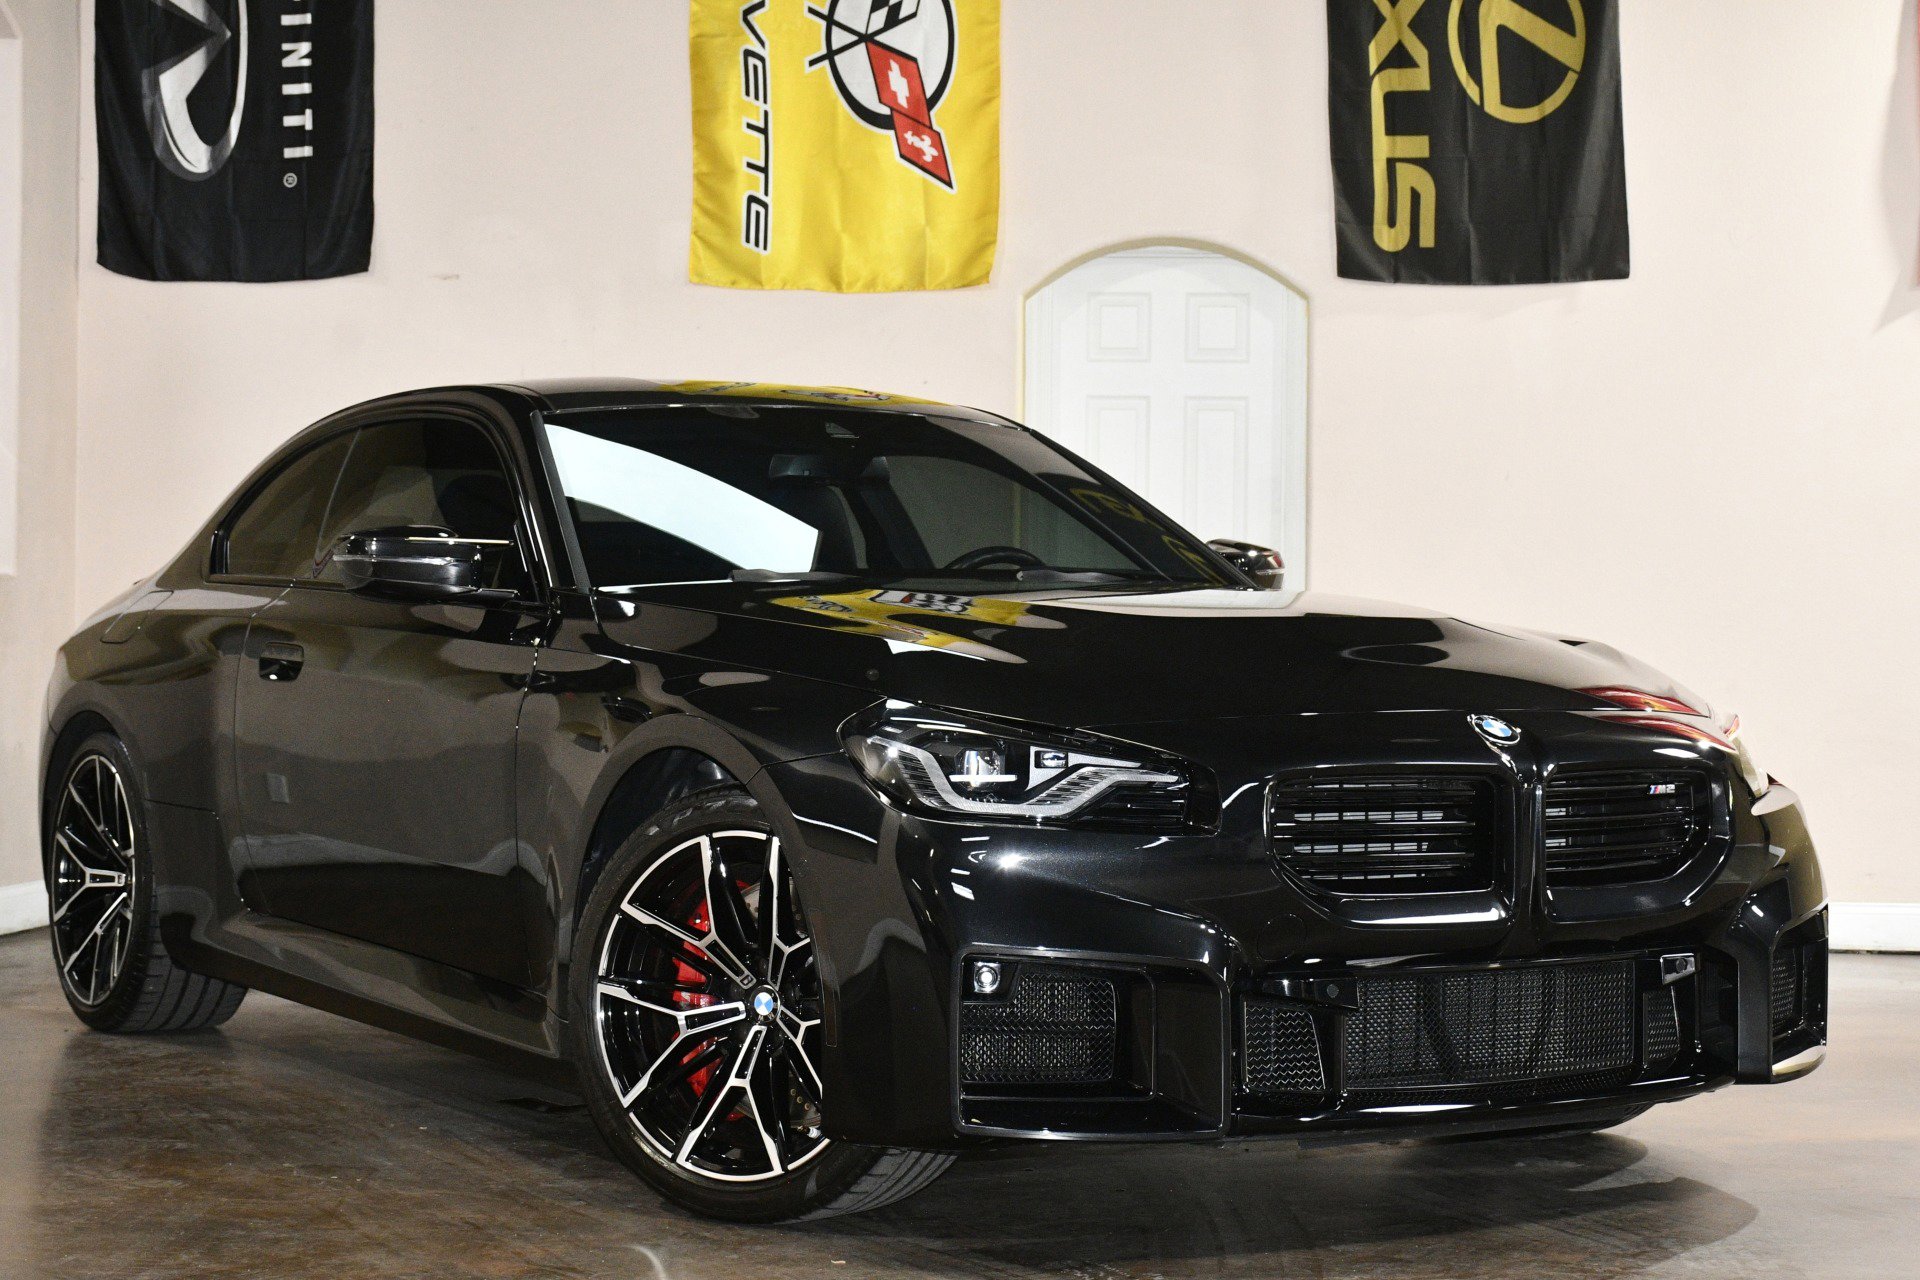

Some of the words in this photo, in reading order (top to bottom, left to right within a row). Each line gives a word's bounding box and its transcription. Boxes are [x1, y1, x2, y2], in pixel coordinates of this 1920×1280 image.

[281, 0, 313, 159] INITI
[742, 0, 769, 251] VETTE
[1369, 0, 1436, 252] XUS
